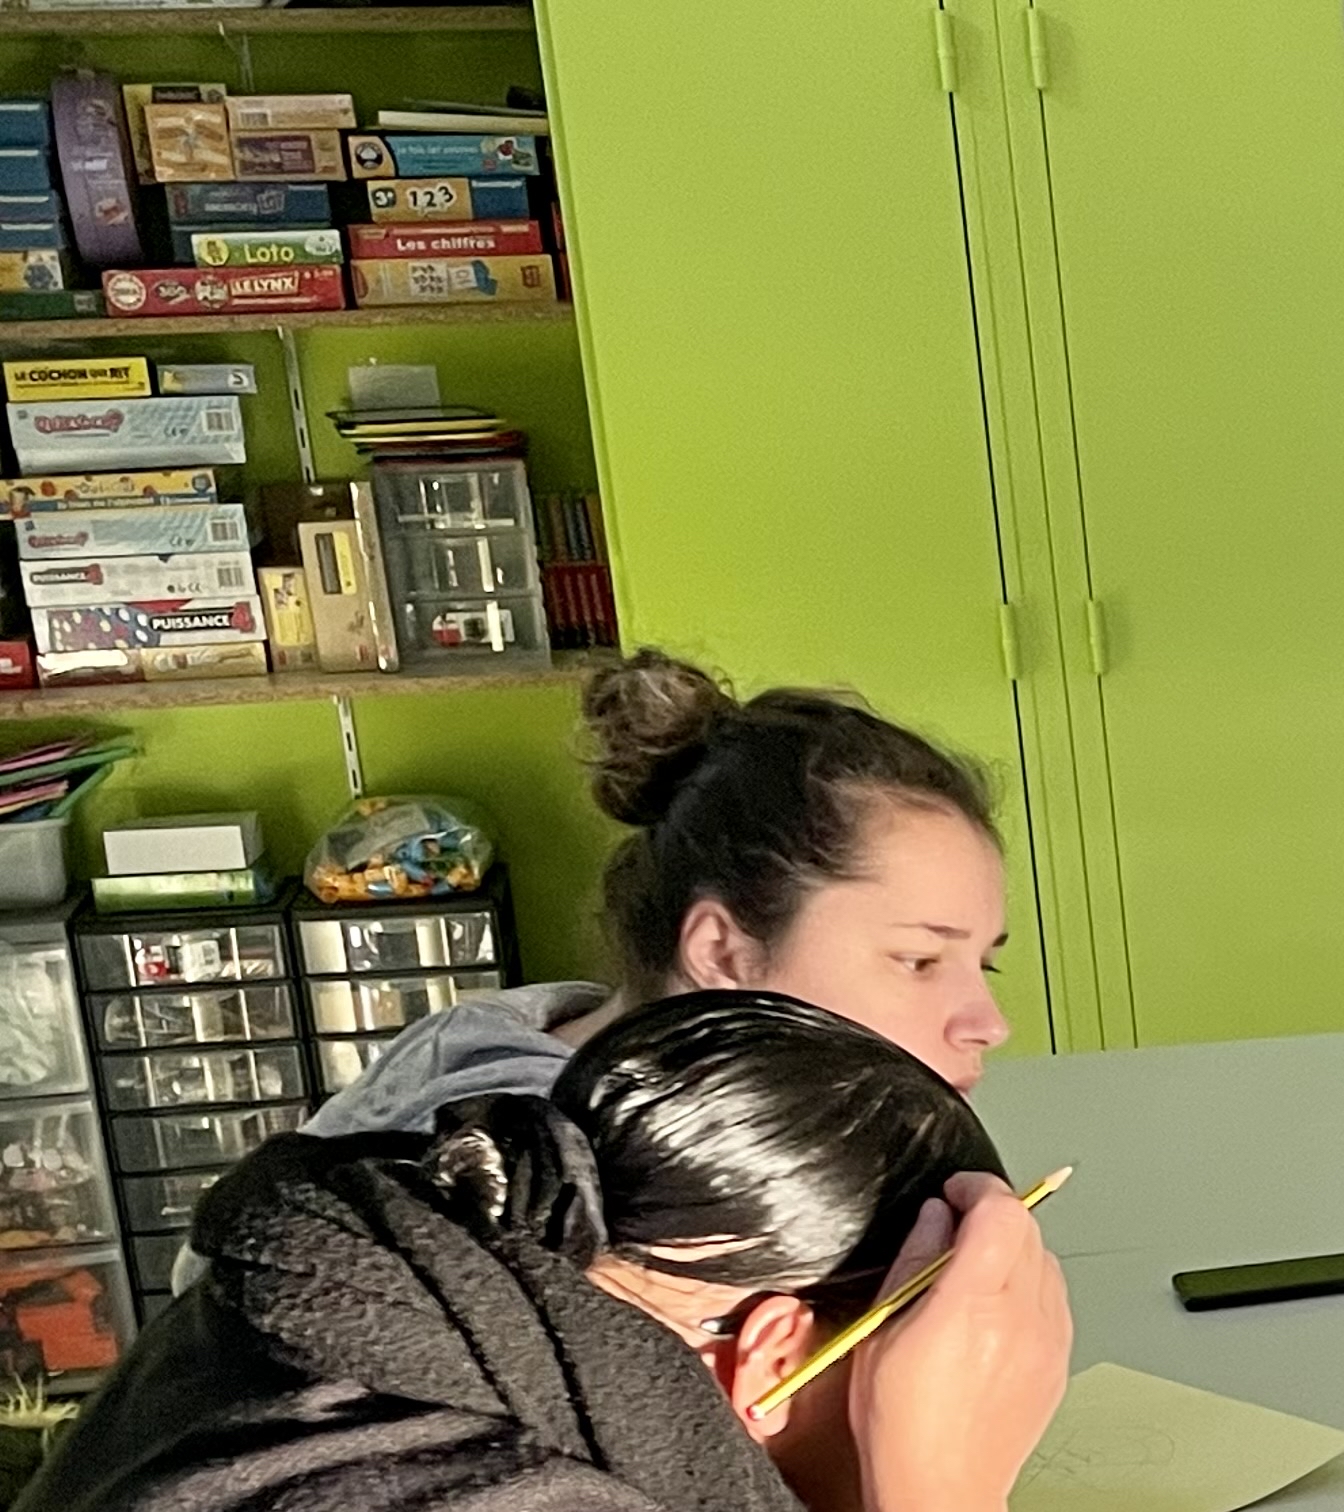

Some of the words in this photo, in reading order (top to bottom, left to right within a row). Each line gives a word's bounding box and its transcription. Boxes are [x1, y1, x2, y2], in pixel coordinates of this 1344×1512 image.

[396, 239, 426, 251] Les
[430, 237, 496, 250] chiffres
[243, 243, 294, 263] Loto
[253, 275, 297, 292] LYNX
[29, 367, 88, 383] COCHON
[152, 612, 230, 630] PUISSANCE
